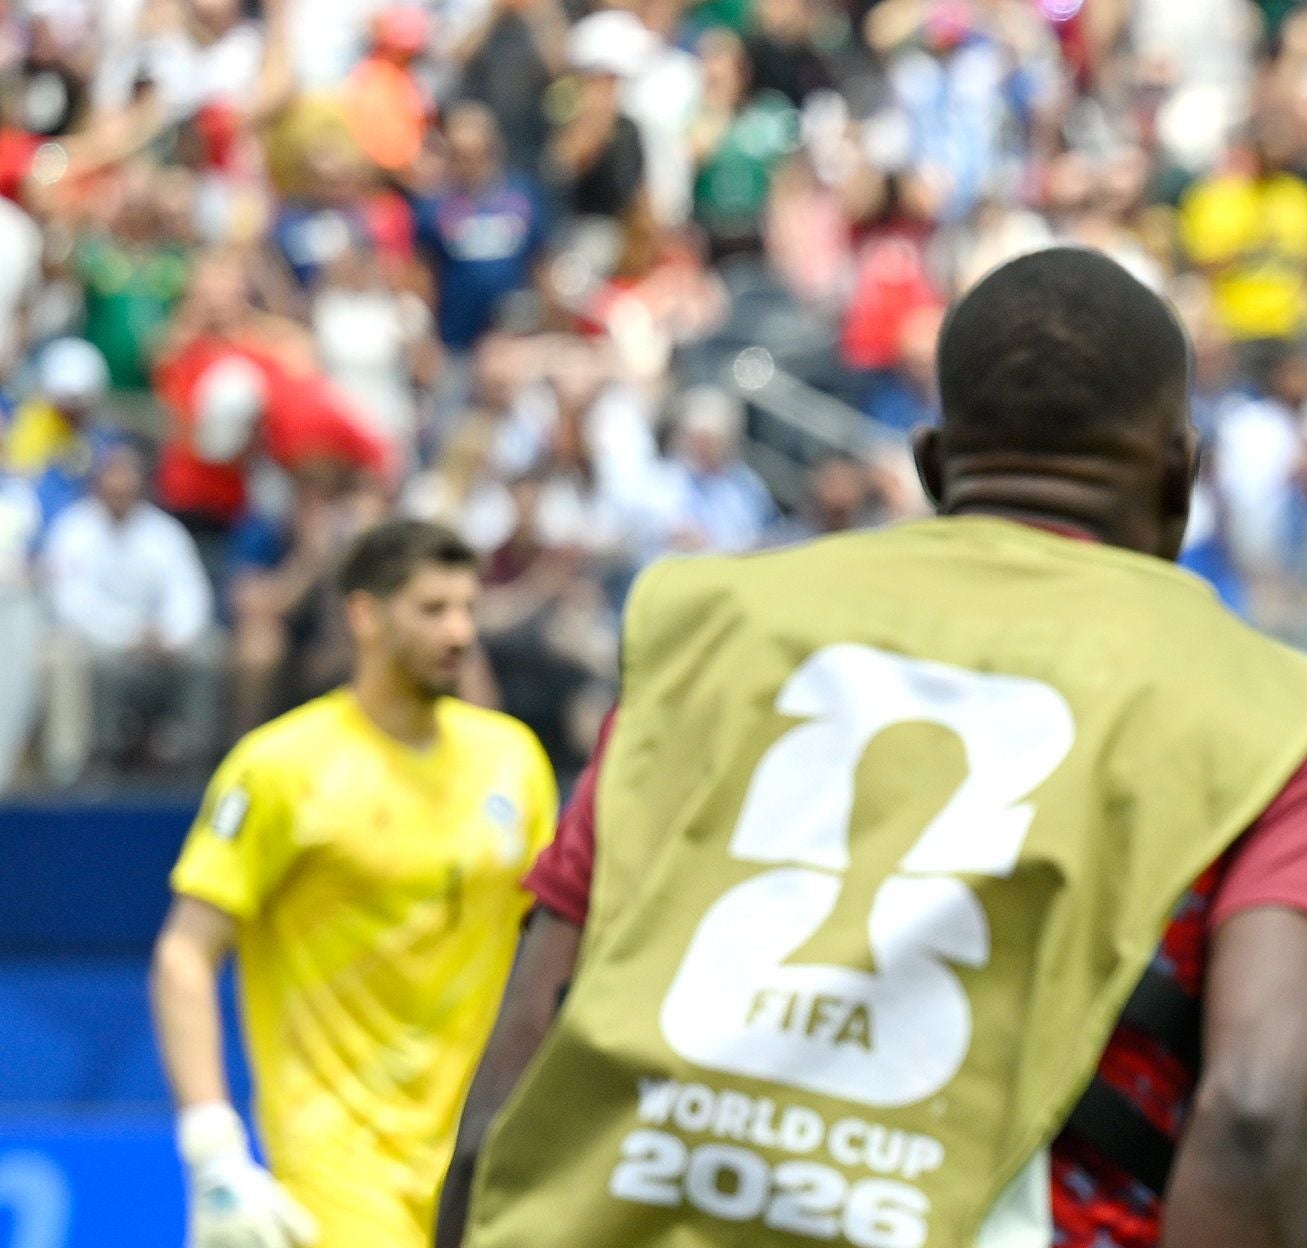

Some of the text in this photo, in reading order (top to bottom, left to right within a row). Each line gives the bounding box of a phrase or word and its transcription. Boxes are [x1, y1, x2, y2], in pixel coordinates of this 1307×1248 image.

[747, 989, 874, 1054] FIFA
[636, 1076, 945, 1179] WORLD CUP
